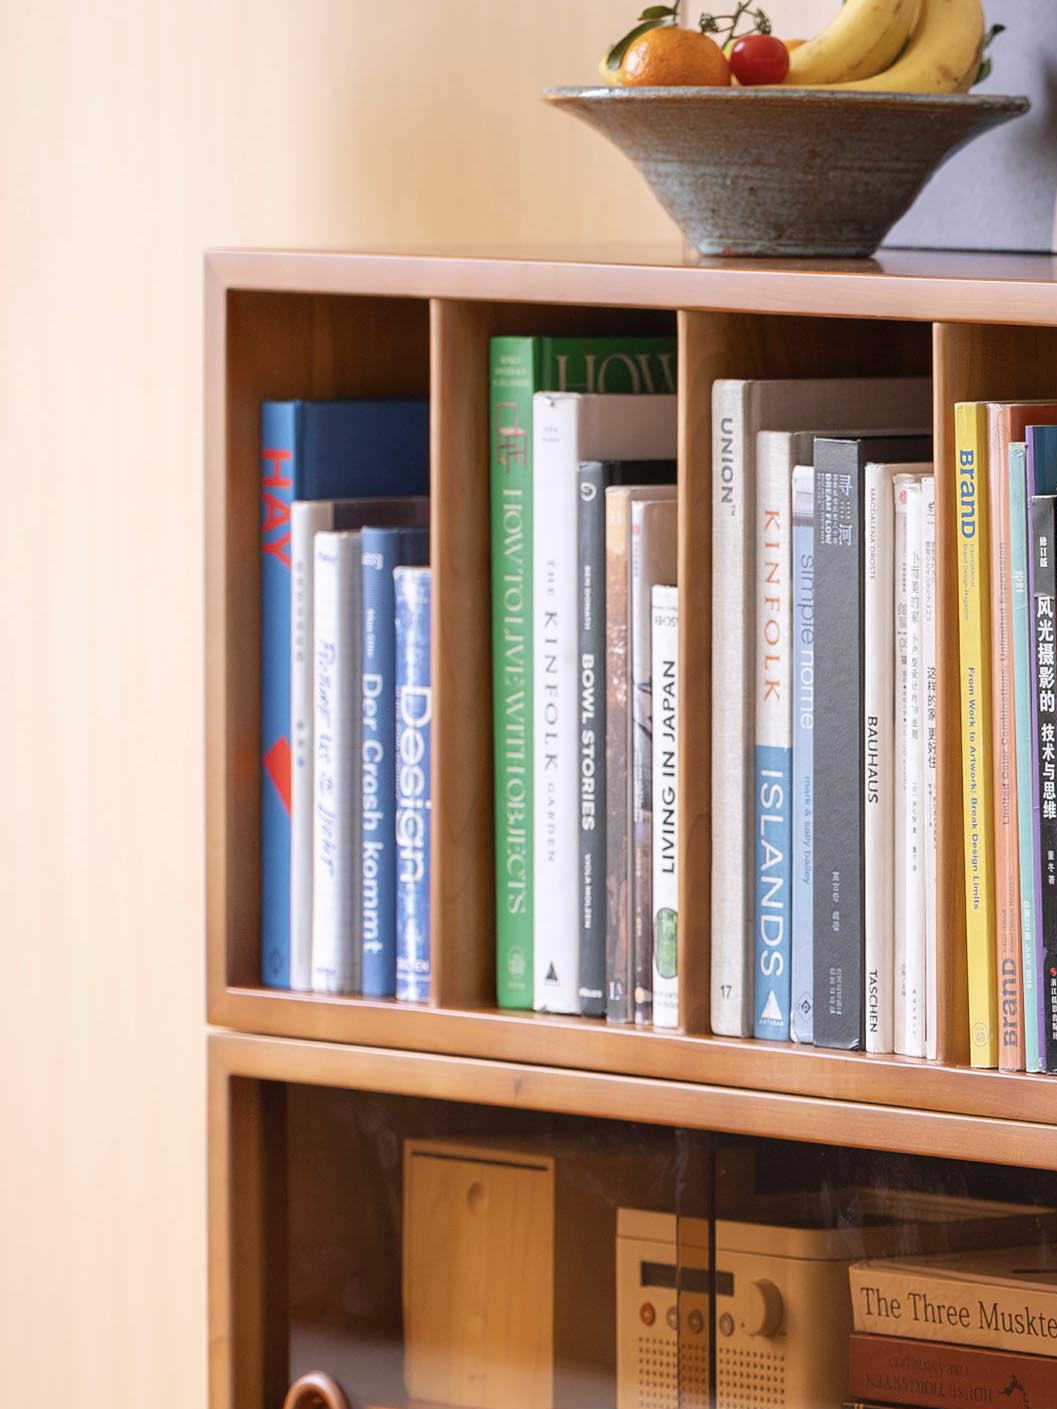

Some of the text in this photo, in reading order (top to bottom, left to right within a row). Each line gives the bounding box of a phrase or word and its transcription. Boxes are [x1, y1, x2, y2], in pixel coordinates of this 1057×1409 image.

[263, 448, 292, 570] HAY
[502, 488, 525, 564] HOW
[825, 472, 834, 545] DREAM FLOW
[869, 488, 877, 544] MAGDALENA
[503, 569, 525, 613] TO
[504, 616, 527, 689] LIVE
[505, 689, 527, 772] WITH
[543, 560, 559, 864] THE KINFOLK GARDEN
[581, 653, 597, 831] BOWL STORIES
[760, 509, 785, 977] KINFOLK ISLANDS
[1037, 595, 1057, 820] 风光摄影的 技术与思维
[396, 686, 432, 885] Design
[661, 659, 675, 874] LIVING IN JAPAN
[867, 716, 879, 805] BAUHAUS
[967, 666, 982, 910] From Work to Artwork: Break Design Limits
[1001, 749, 1009, 780] Color
[1001, 782, 1010, 826] Limited
[362, 673, 384, 955] Der Crash kommt
[505, 777, 528, 915] OBJECTS
[802, 775, 813, 885] mark & sally bailey
[720, 983, 732, 999] 17
[869, 968, 879, 1034] TASCHEN
[860, 1286, 902, 1320] The
[907, 1291, 970, 1328] Three
